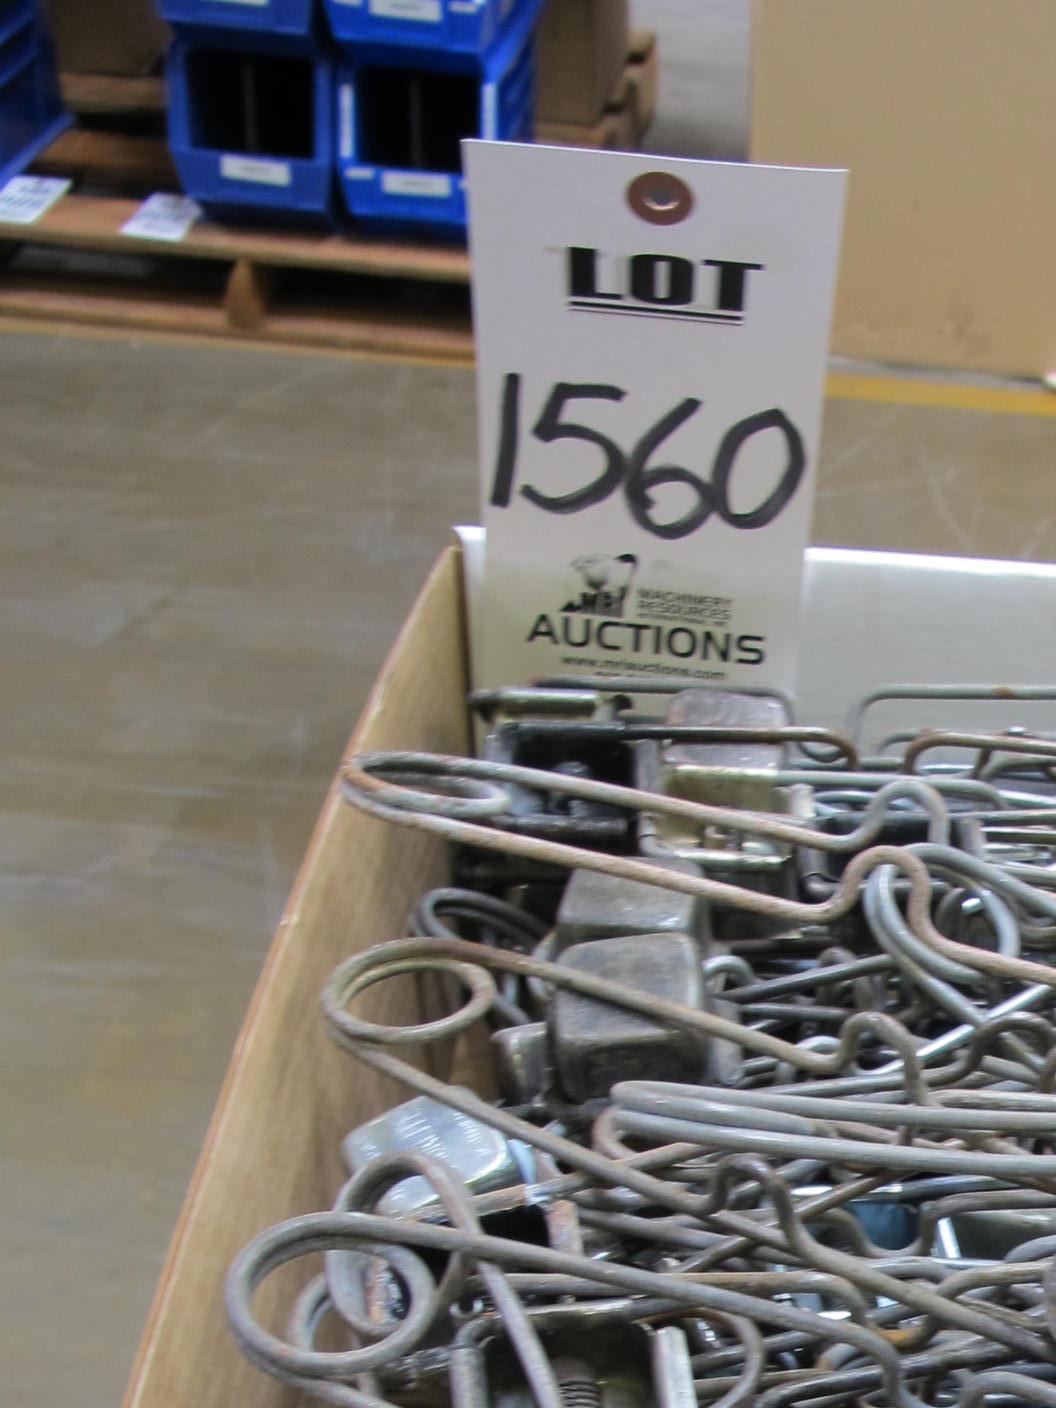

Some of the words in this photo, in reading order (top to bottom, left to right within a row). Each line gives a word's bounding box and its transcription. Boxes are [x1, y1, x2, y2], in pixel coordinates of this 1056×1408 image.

[565, 246, 765, 312] LOT
[490, 372, 806, 540] 1560
[526, 613, 766, 665] AUCTIONS
